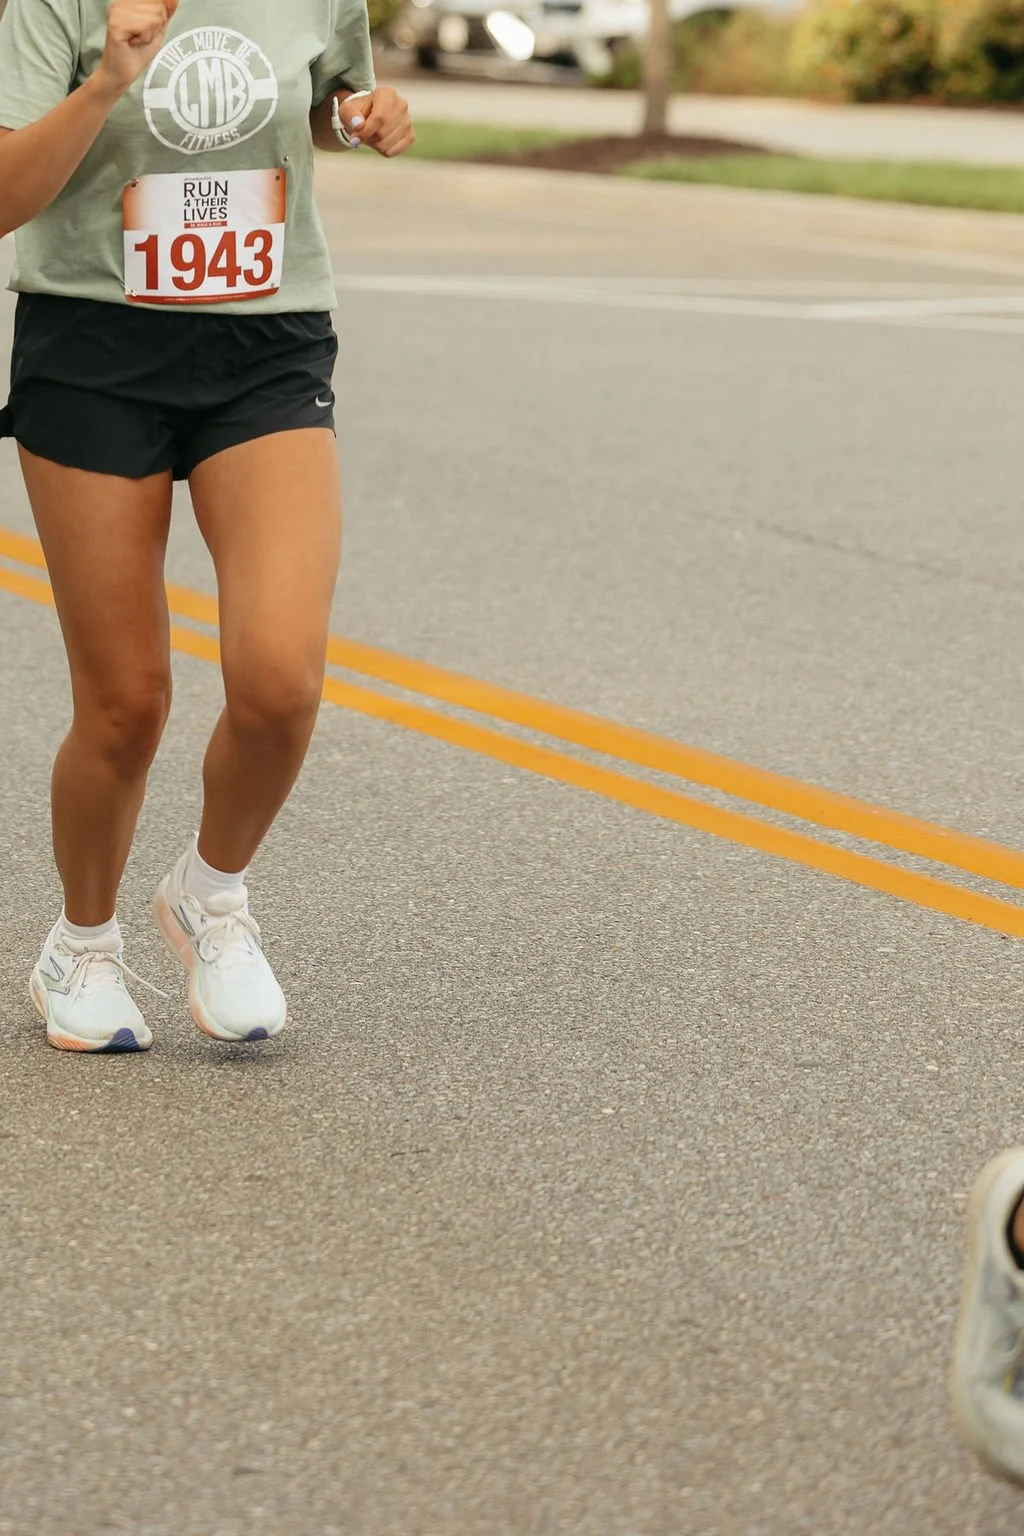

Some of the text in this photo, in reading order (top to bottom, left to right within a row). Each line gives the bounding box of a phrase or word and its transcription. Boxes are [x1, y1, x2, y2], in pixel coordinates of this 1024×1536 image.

[178, 57, 248, 128] LMB
[178, 127, 241, 151] FITNESS
[183, 180, 228, 198] RUN
[184, 197, 228, 207] 4 THEIR
[183, 206, 228, 222] LIVES
[134, 229, 273, 291] 1943
